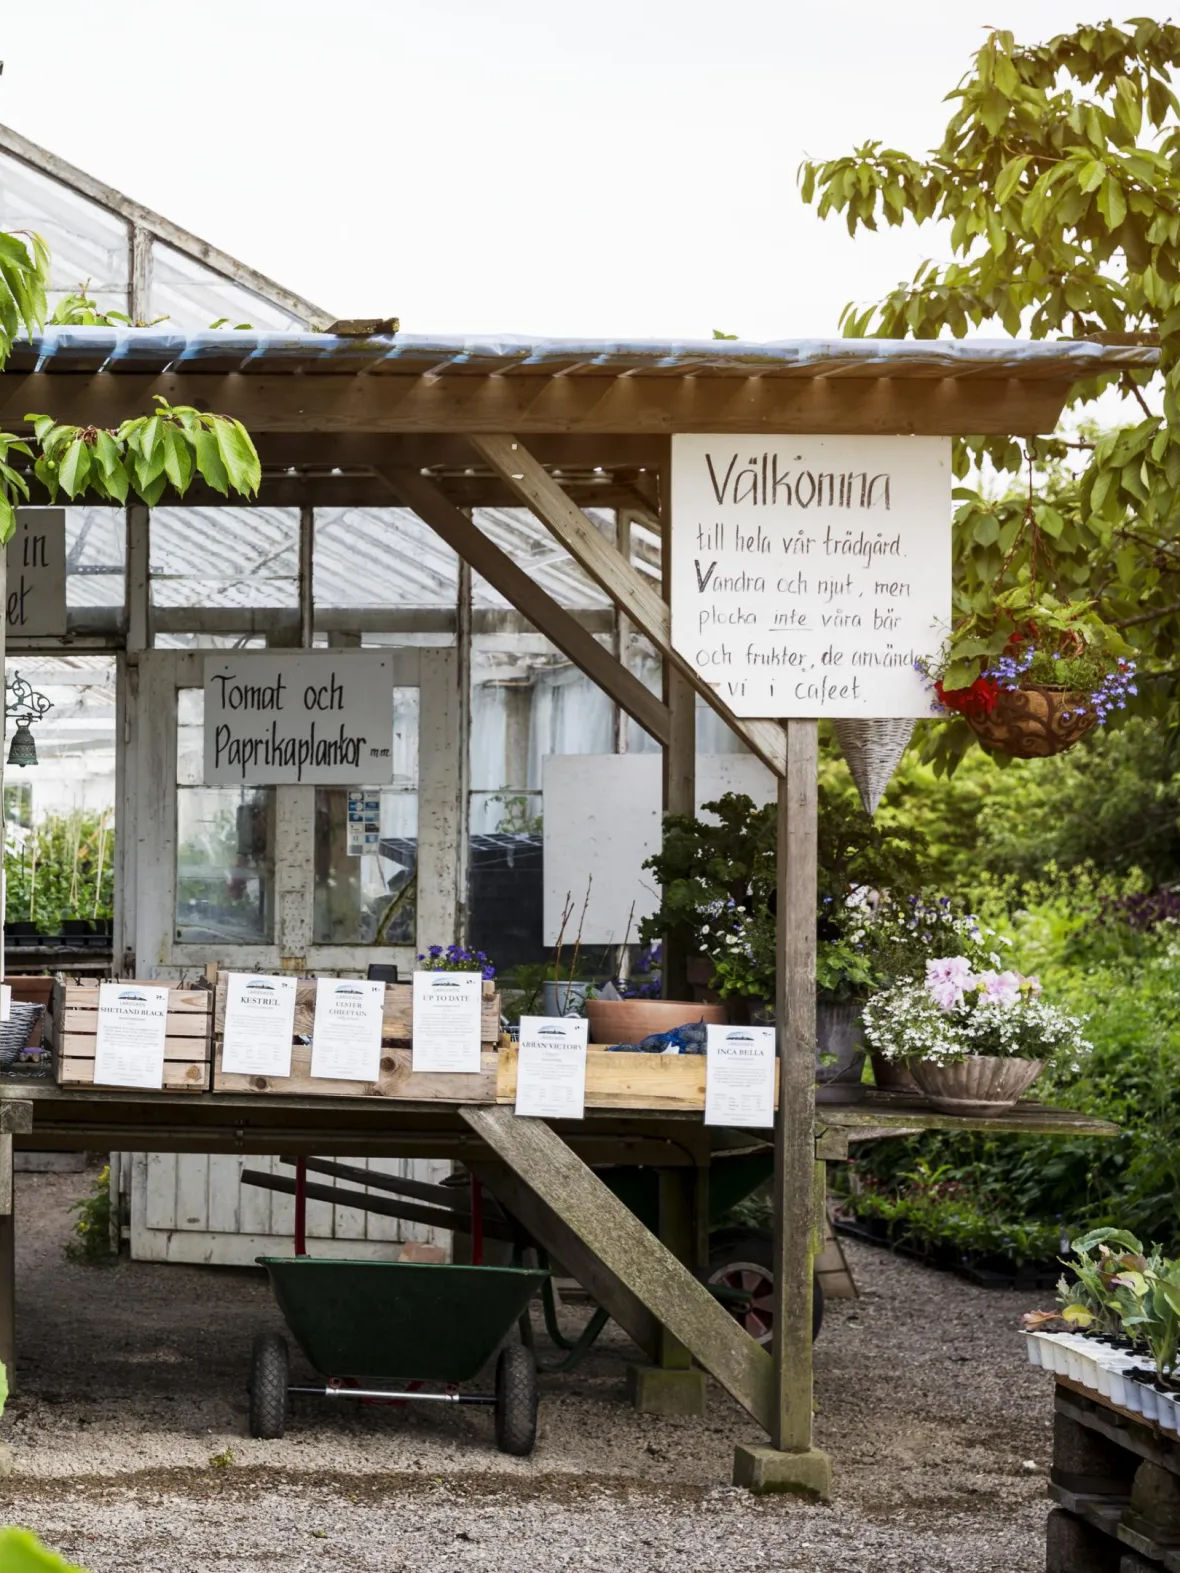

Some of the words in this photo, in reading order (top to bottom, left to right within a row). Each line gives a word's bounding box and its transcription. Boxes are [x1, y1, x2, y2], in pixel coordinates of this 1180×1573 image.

[705, 453, 891, 510] Välkomna
[23, 524, 49, 568] in
[696, 523, 724, 551] till
[735, 525, 771, 553] hela
[783, 530, 816, 555] vår
[823, 525, 907, 569] trädgård.
[694, 559, 765, 593] Vandra
[777, 571, 808, 596] och
[875, 580, 910, 597] men
[698, 605, 757, 635] plocka
[773, 609, 807, 627] inte
[821, 608, 861, 628] våra
[873, 607, 902, 631] bär
[696, 643, 731, 666] och
[821, 644, 843, 666] de
[211, 673, 286, 711] Tomat
[304, 672, 344, 711] och
[728, 679, 748, 698] vi
[769, 679, 775, 698] i
[215, 720, 367, 782] Paprikaplantor
[141, 1010, 165, 1018] BLACK
[240, 996, 281, 1006] KESTREL
[717, 1048, 737, 1056] INCA
